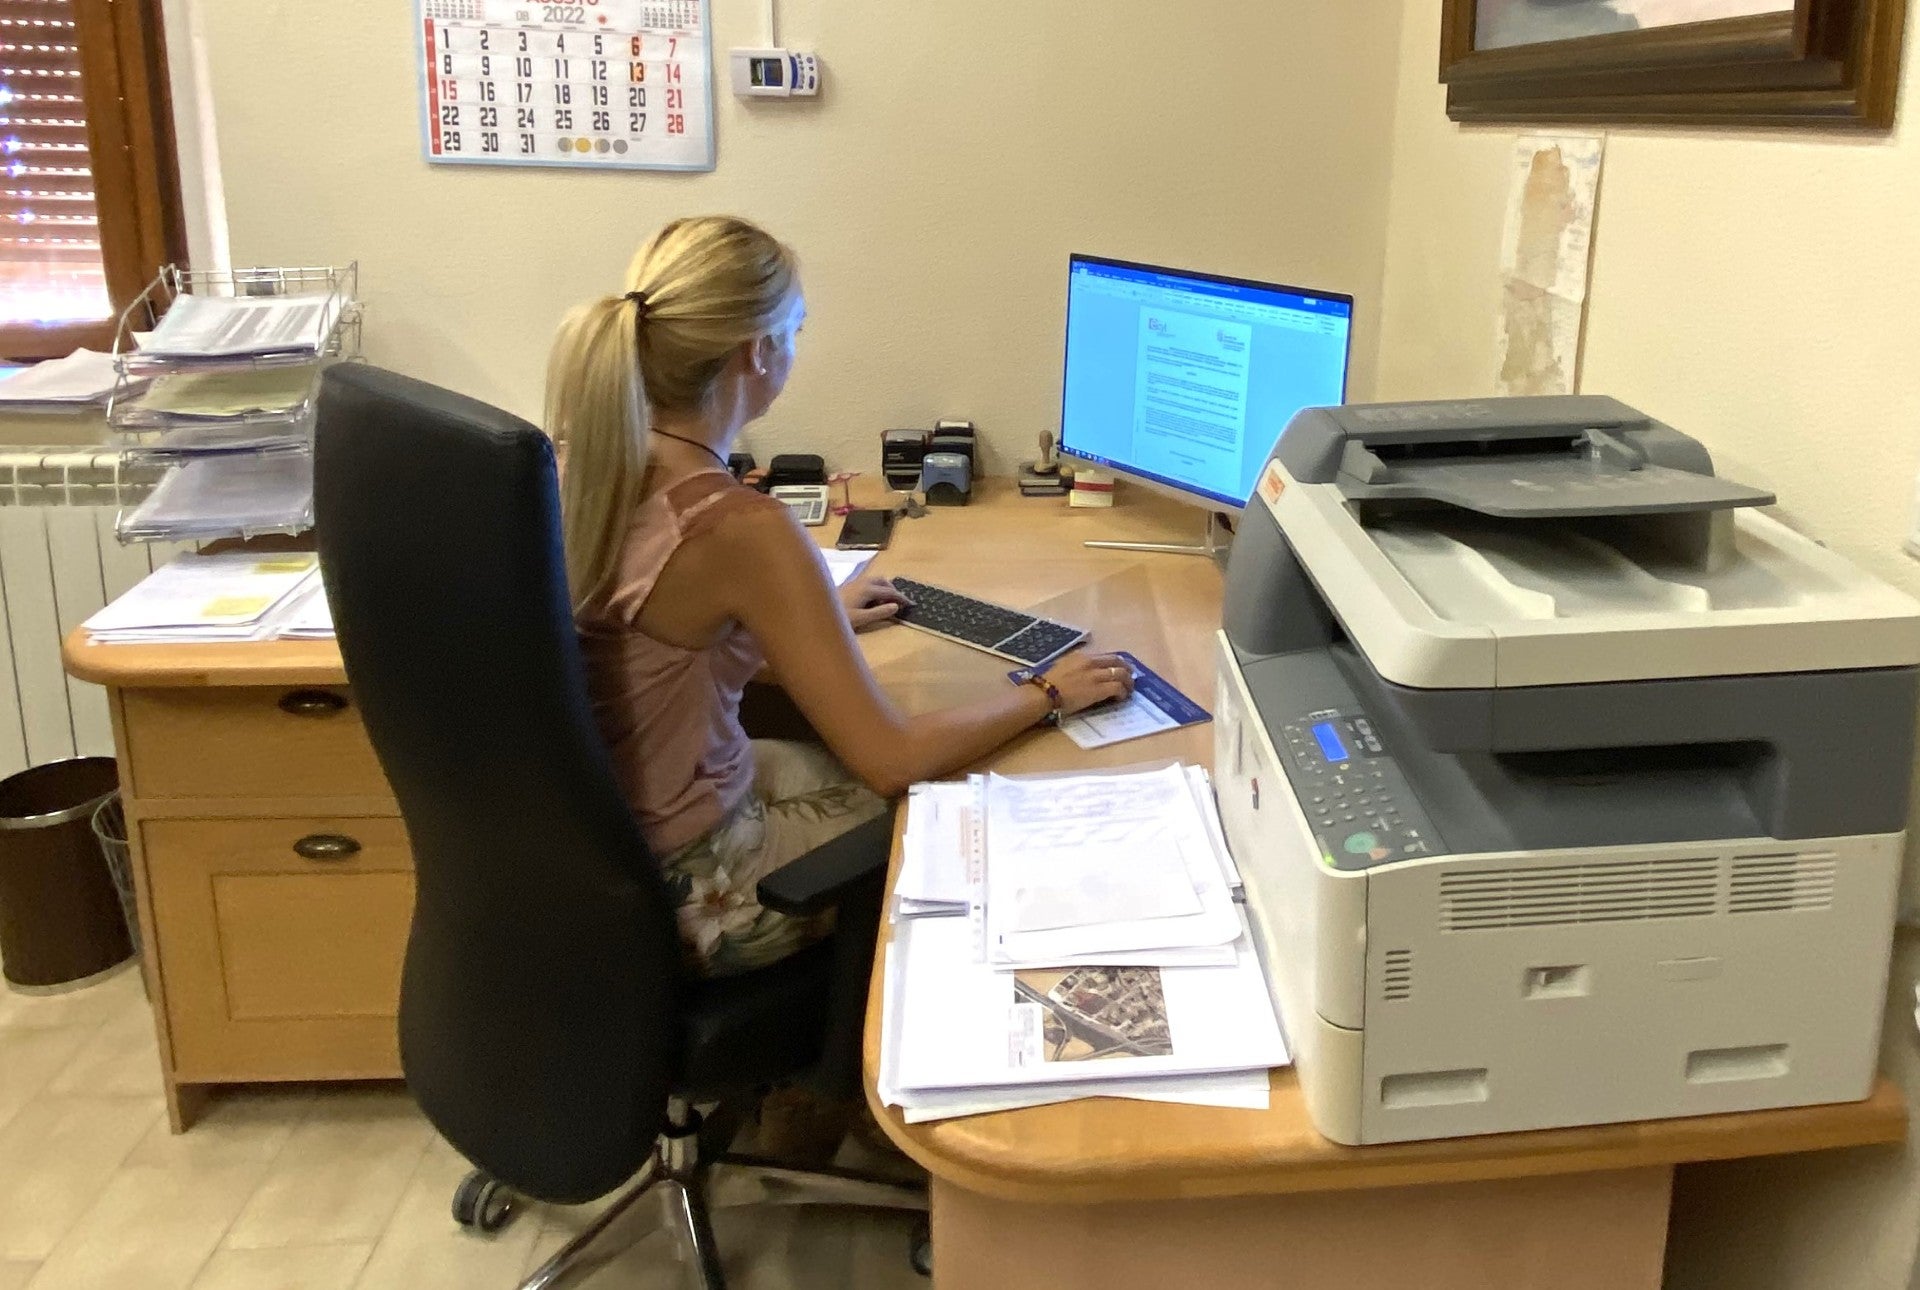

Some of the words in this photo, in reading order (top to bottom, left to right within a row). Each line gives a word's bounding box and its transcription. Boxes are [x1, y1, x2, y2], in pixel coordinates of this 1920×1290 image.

[543, 5, 585, 24] 2022
[443, 28, 450, 49] 1
[480, 30, 489, 50] 2
[518, 31, 527, 52] 3
[557, 33, 565, 53] 4
[594, 34, 603, 55] 5
[631, 36, 640, 57] 6
[668, 37, 677, 58] 7
[444, 54, 452, 75] 8
[482, 55, 490, 76] 9
[516, 57, 532, 78] 10
[555, 58, 569, 79] 11
[591, 60, 607, 81] 12
[629, 62, 644, 82] 13
[665, 63, 681, 83] 14
[441, 79, 457, 100] 15
[479, 81, 495, 102] 16
[517, 83, 532, 103] 17
[555, 84, 571, 105] 18
[592, 85, 608, 106] 19
[629, 87, 646, 107] 20
[667, 88, 682, 109] 21
[442, 105, 460, 126] 22
[480, 107, 498, 127] 23
[517, 108, 535, 128] 24
[555, 109, 572, 130] 25
[593, 111, 610, 131] 26
[630, 112, 646, 132] 27
[667, 113, 684, 134] 28
[443, 131, 461, 151] 29
[481, 132, 499, 152] 30
[520, 133, 535, 154] 31
